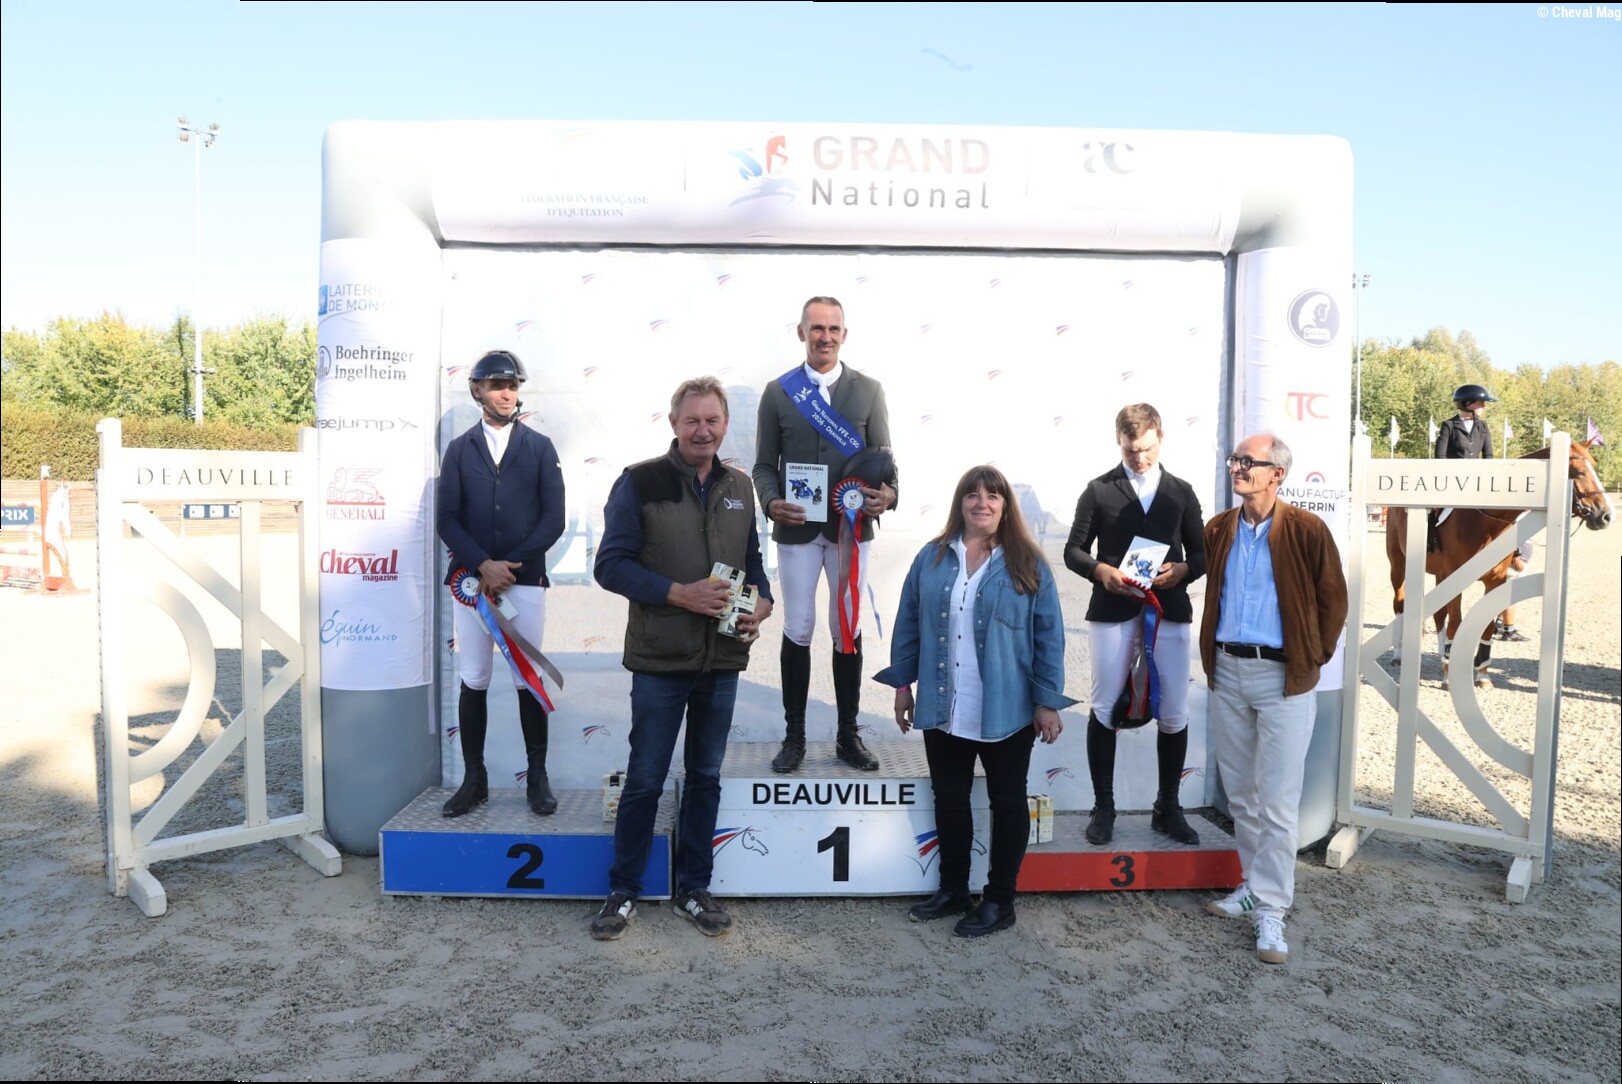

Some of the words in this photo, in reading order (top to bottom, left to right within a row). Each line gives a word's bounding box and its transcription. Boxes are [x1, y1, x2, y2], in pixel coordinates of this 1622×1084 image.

[812, 135, 990, 174] GRAND
[811, 178, 989, 209] National
[328, 299, 342, 312] DE
[335, 345, 414, 365] Boehringer
[334, 364, 406, 382] Ingelheim
[136, 466, 293, 486] DEAUVILLE
[1378, 475, 1536, 493] DEAUVILLE
[326, 507, 385, 520] GENERALI
[320, 548, 399, 575] Cheval
[362, 574, 398, 582] magazine
[343, 634, 398, 642] NORMAND
[752, 783, 916, 805] DEAUVILLE
[817, 826, 850, 882] 1
[506, 843, 545, 889] 2
[1110, 855, 1136, 887] 3
